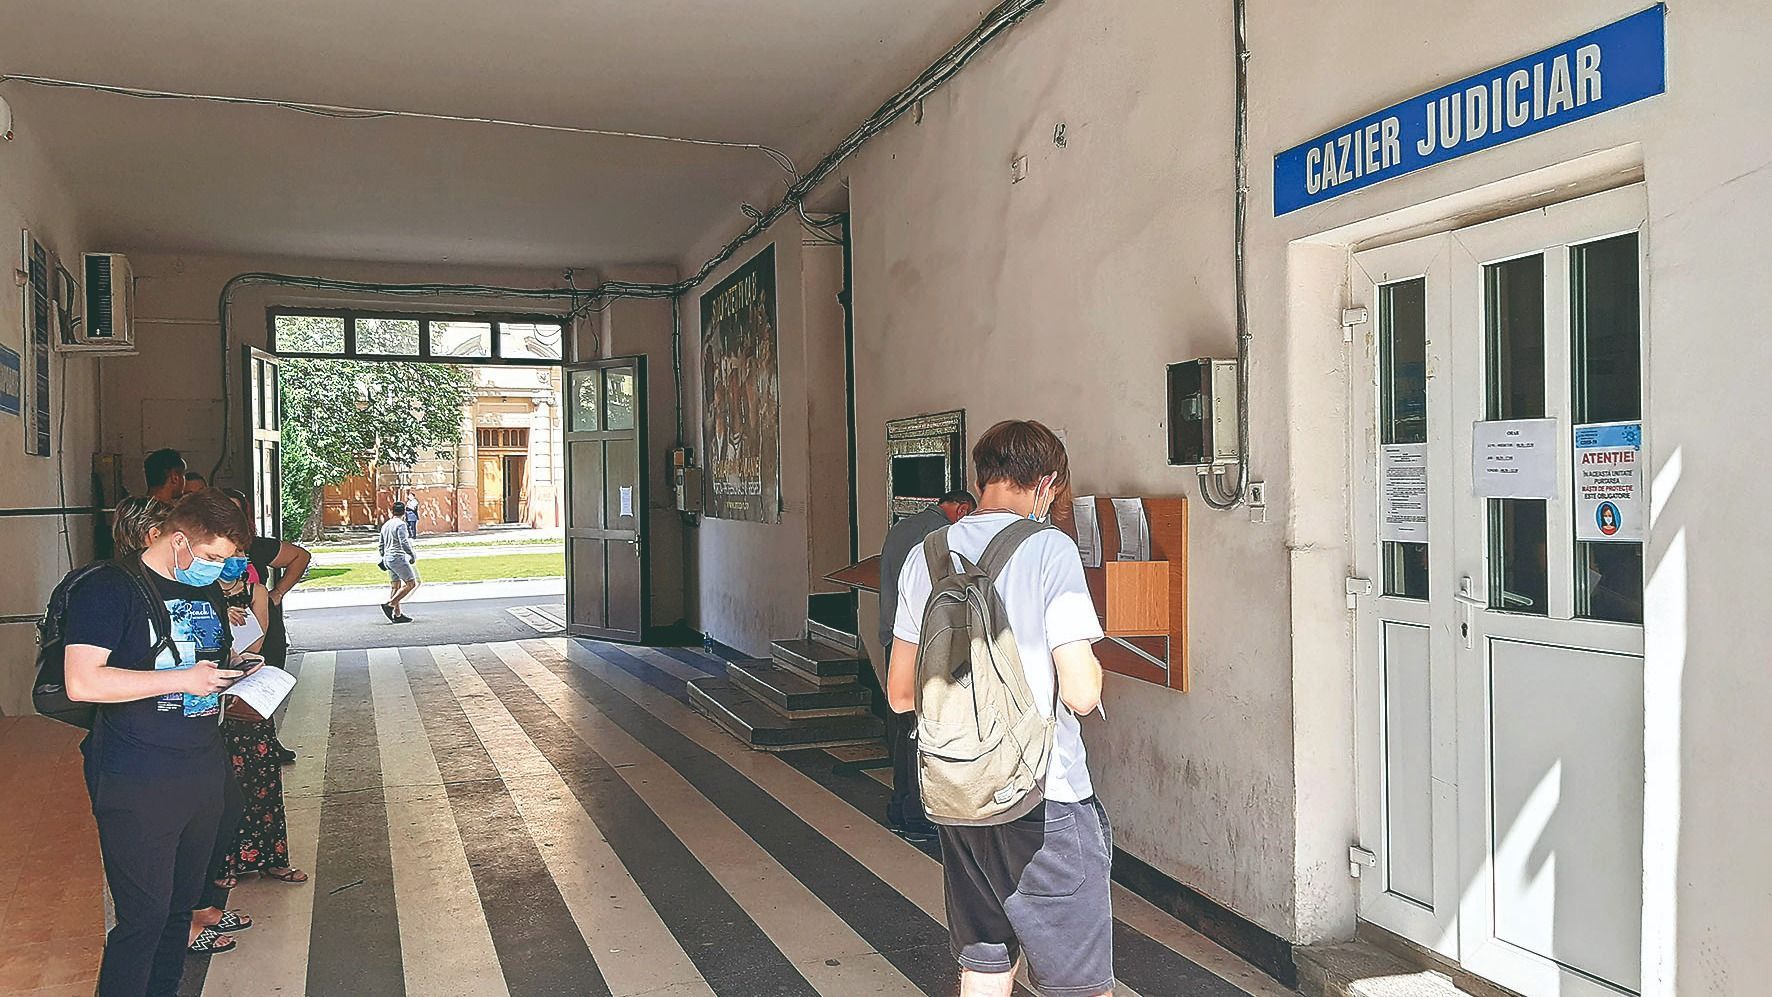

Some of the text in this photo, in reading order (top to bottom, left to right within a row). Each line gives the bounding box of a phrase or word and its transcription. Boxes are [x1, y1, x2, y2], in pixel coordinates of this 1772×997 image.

[1305, 43, 1602, 195] CAZIER JUDICIAR
[1582, 452, 1634, 466] ATENȚIE!
